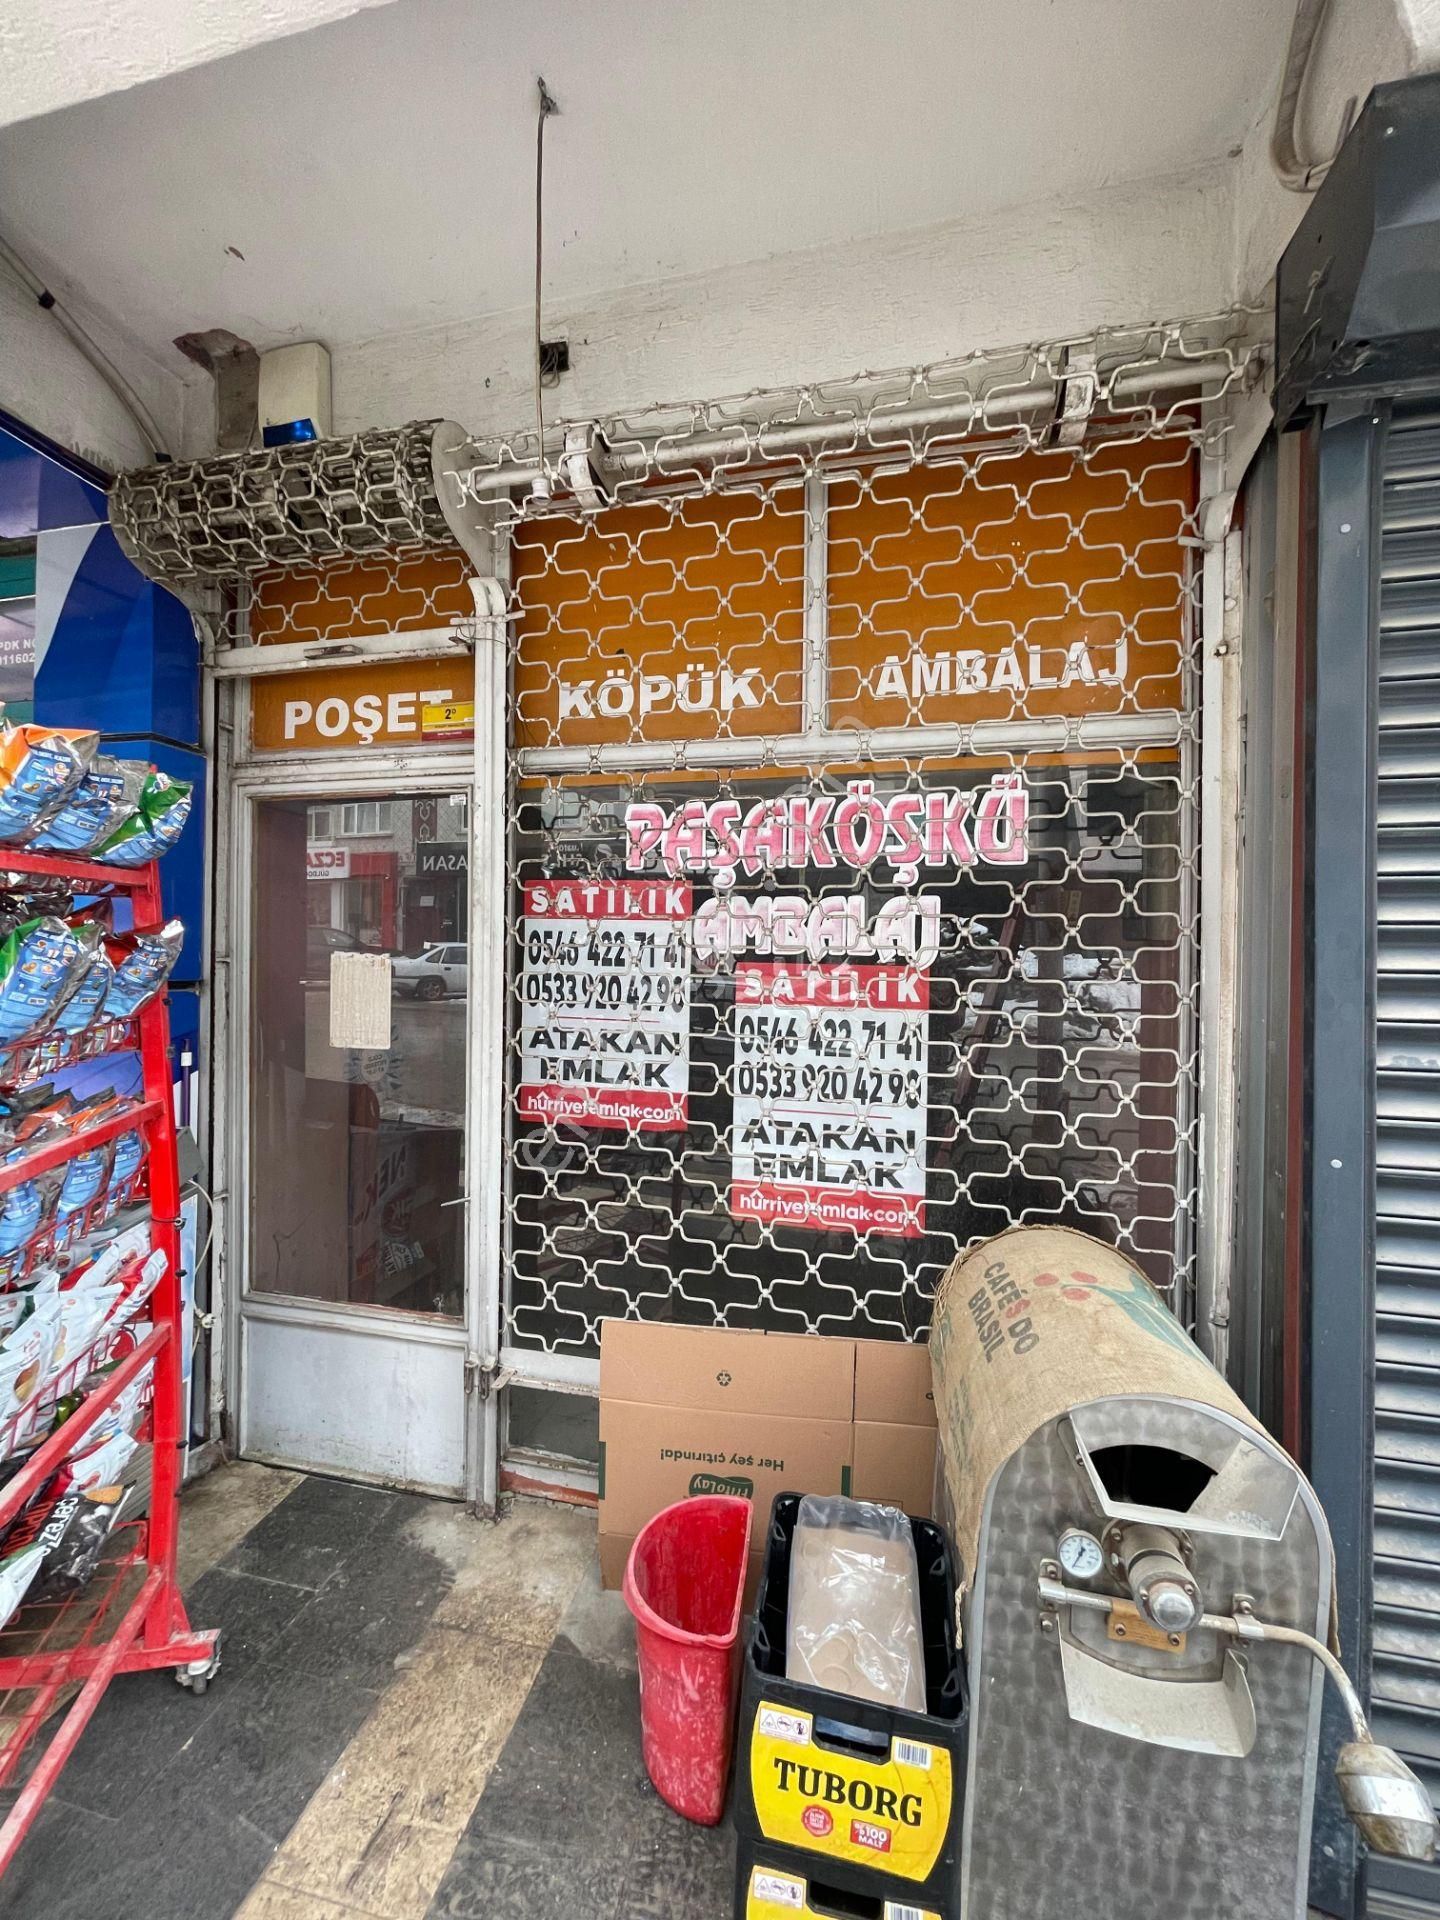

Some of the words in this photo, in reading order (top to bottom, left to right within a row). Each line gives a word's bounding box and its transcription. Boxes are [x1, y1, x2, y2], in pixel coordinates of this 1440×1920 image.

[875, 638, 1128, 699] AMBALAJ
[558, 664, 764, 719] KÖPÜK
[284, 689, 453, 745] POŞET
[625, 773, 1030, 889] PAŞAKÖŞKÜ
[531, 885, 686, 915] SATILIK
[528, 929, 579, 966] 0546
[587, 931, 625, 967] 422
[634, 932, 655, 968] 71
[664, 932, 686, 969] 41
[695, 893, 941, 972] AMBALAJ
[527, 973, 577, 1008] 0533
[582, 973, 622, 1010] 920
[626, 975, 652, 1011] 42
[657, 976, 684, 1013] 98
[743, 969, 921, 1003] SATILIK
[528, 1026, 681, 1056] ATAKAN
[740, 1015, 799, 1055] 0546
[808, 1018, 852, 1058] 422
[862, 1020, 886, 1060] 71
[897, 1021, 922, 1061] 41
[540, 1056, 670, 1088] EMLAK
[738, 1060, 796, 1100] 0533
[801, 1063, 848, 1103] 920
[853, 1066, 882, 1106] 42
[889, 1068, 921, 1109] 98
[741, 1118, 916, 1154] ATAKAN
[753, 1151, 904, 1190] EMLAK
[968, 1287, 1005, 1363] BRASIL
[984, 1261, 1031, 1319] CAFÉS
[1008, 1317, 1040, 1355] DO
[730, 1452, 754, 1466] şey
[757, 1459, 785, 1472] Her
[774, 1757, 922, 1826] TUBORG
[858, 1833, 883, 1849] MALT
